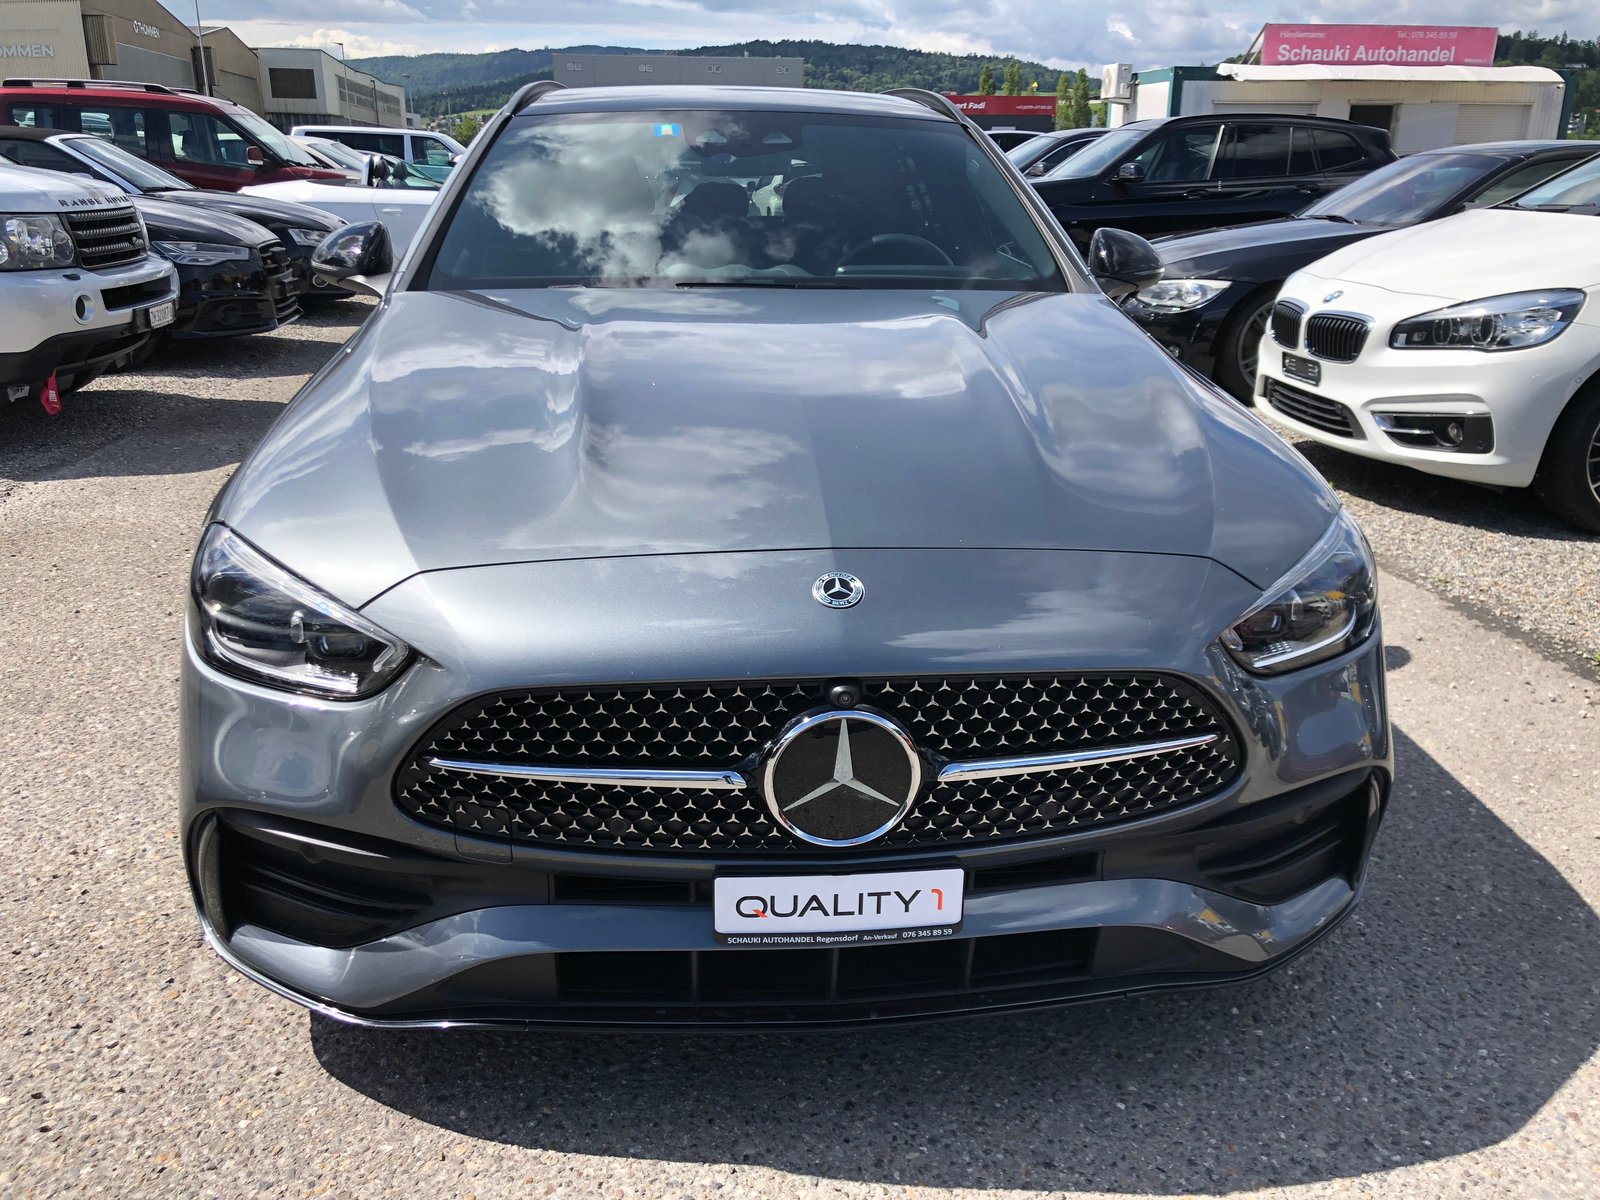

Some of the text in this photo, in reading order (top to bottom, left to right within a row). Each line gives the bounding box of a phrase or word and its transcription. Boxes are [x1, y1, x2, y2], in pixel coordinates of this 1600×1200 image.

[137, 21, 160, 39] THOMMEN
[1277, 44, 1456, 63] Schauki Autohandel
[968, 101, 986, 109] Fadi
[58, 198, 103, 207] RANGE
[735, 888, 944, 918] QUALITY 1
[727, 936, 761, 944] SCHAUKI
[762, 936, 815, 944] AUTOHANDEL
[816, 934, 858, 944] Regensdorf
[863, 933, 898, 941] An-Verkauf
[918, 929, 931, 937] 345
